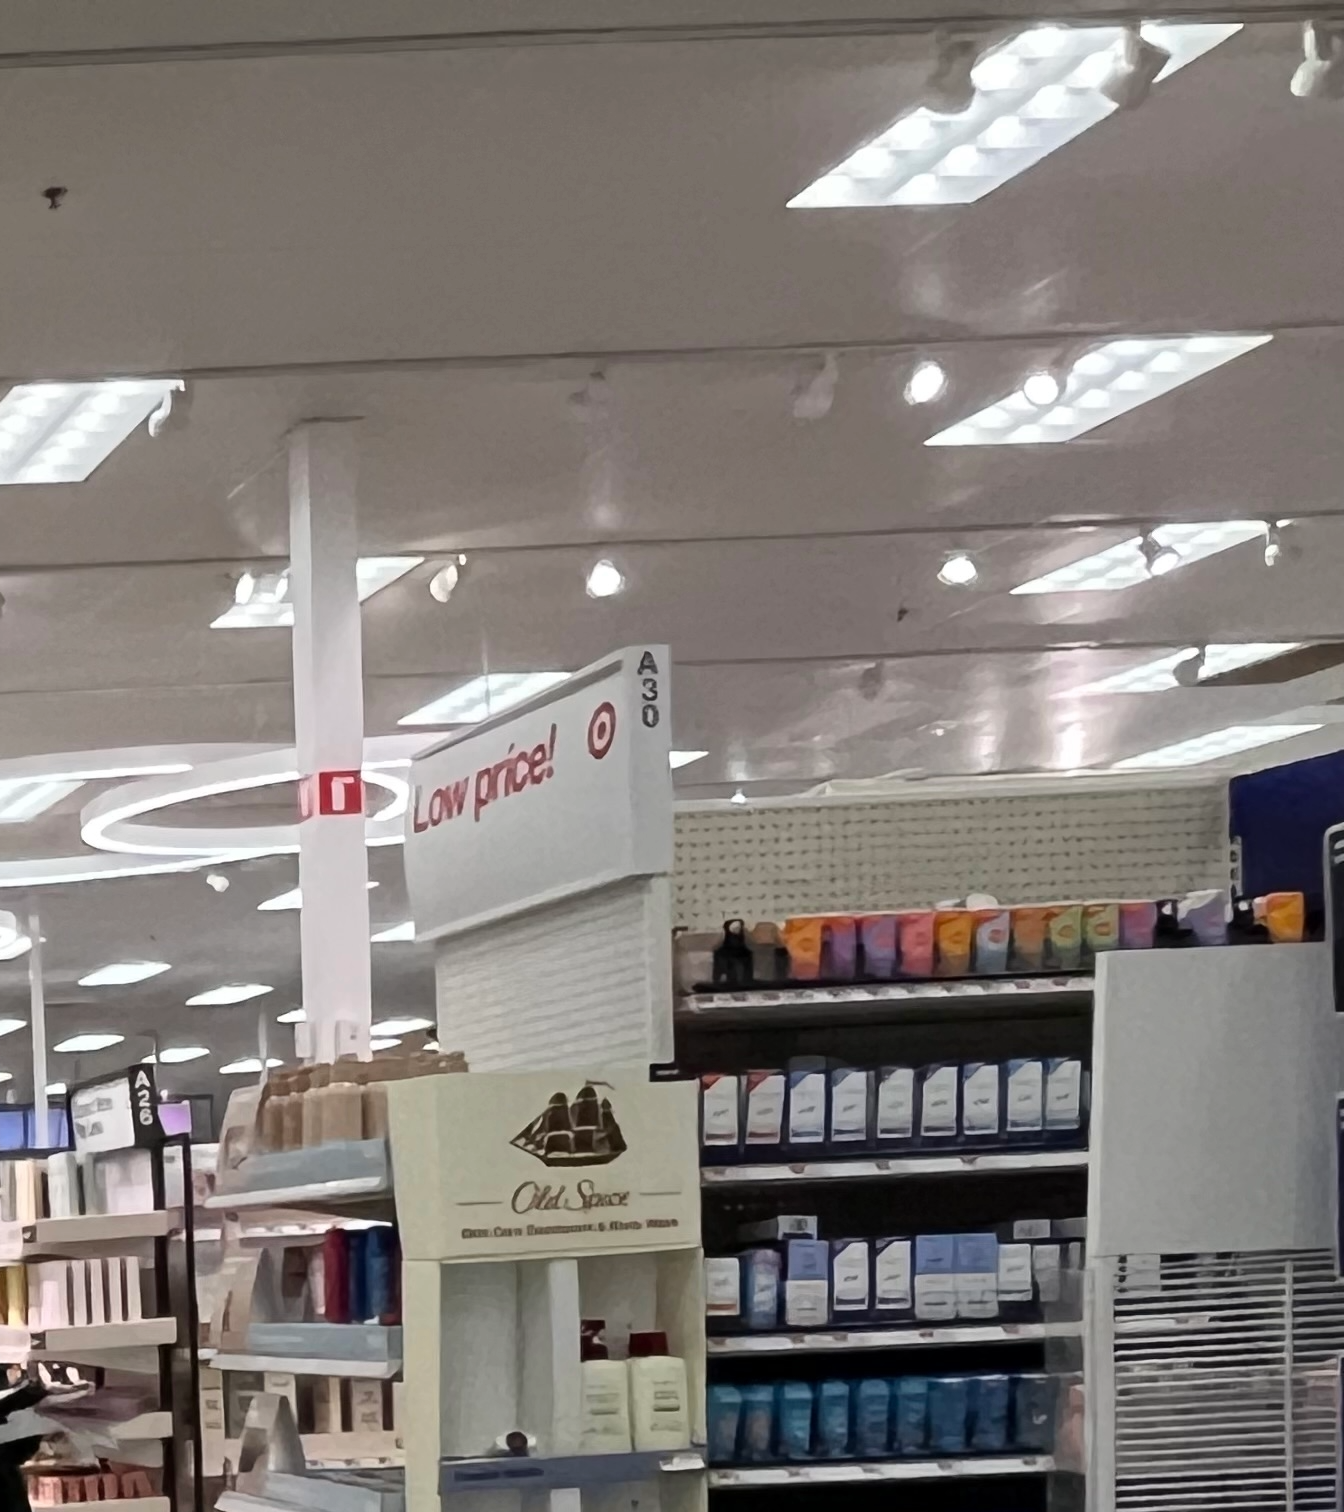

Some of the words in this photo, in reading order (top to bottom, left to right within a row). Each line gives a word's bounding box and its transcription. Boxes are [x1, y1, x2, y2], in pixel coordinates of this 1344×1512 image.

[637, 650, 660, 729] A30
[413, 778, 470, 834] Low
[474, 722, 558, 823] price!
[511, 1180, 566, 1215] Old
